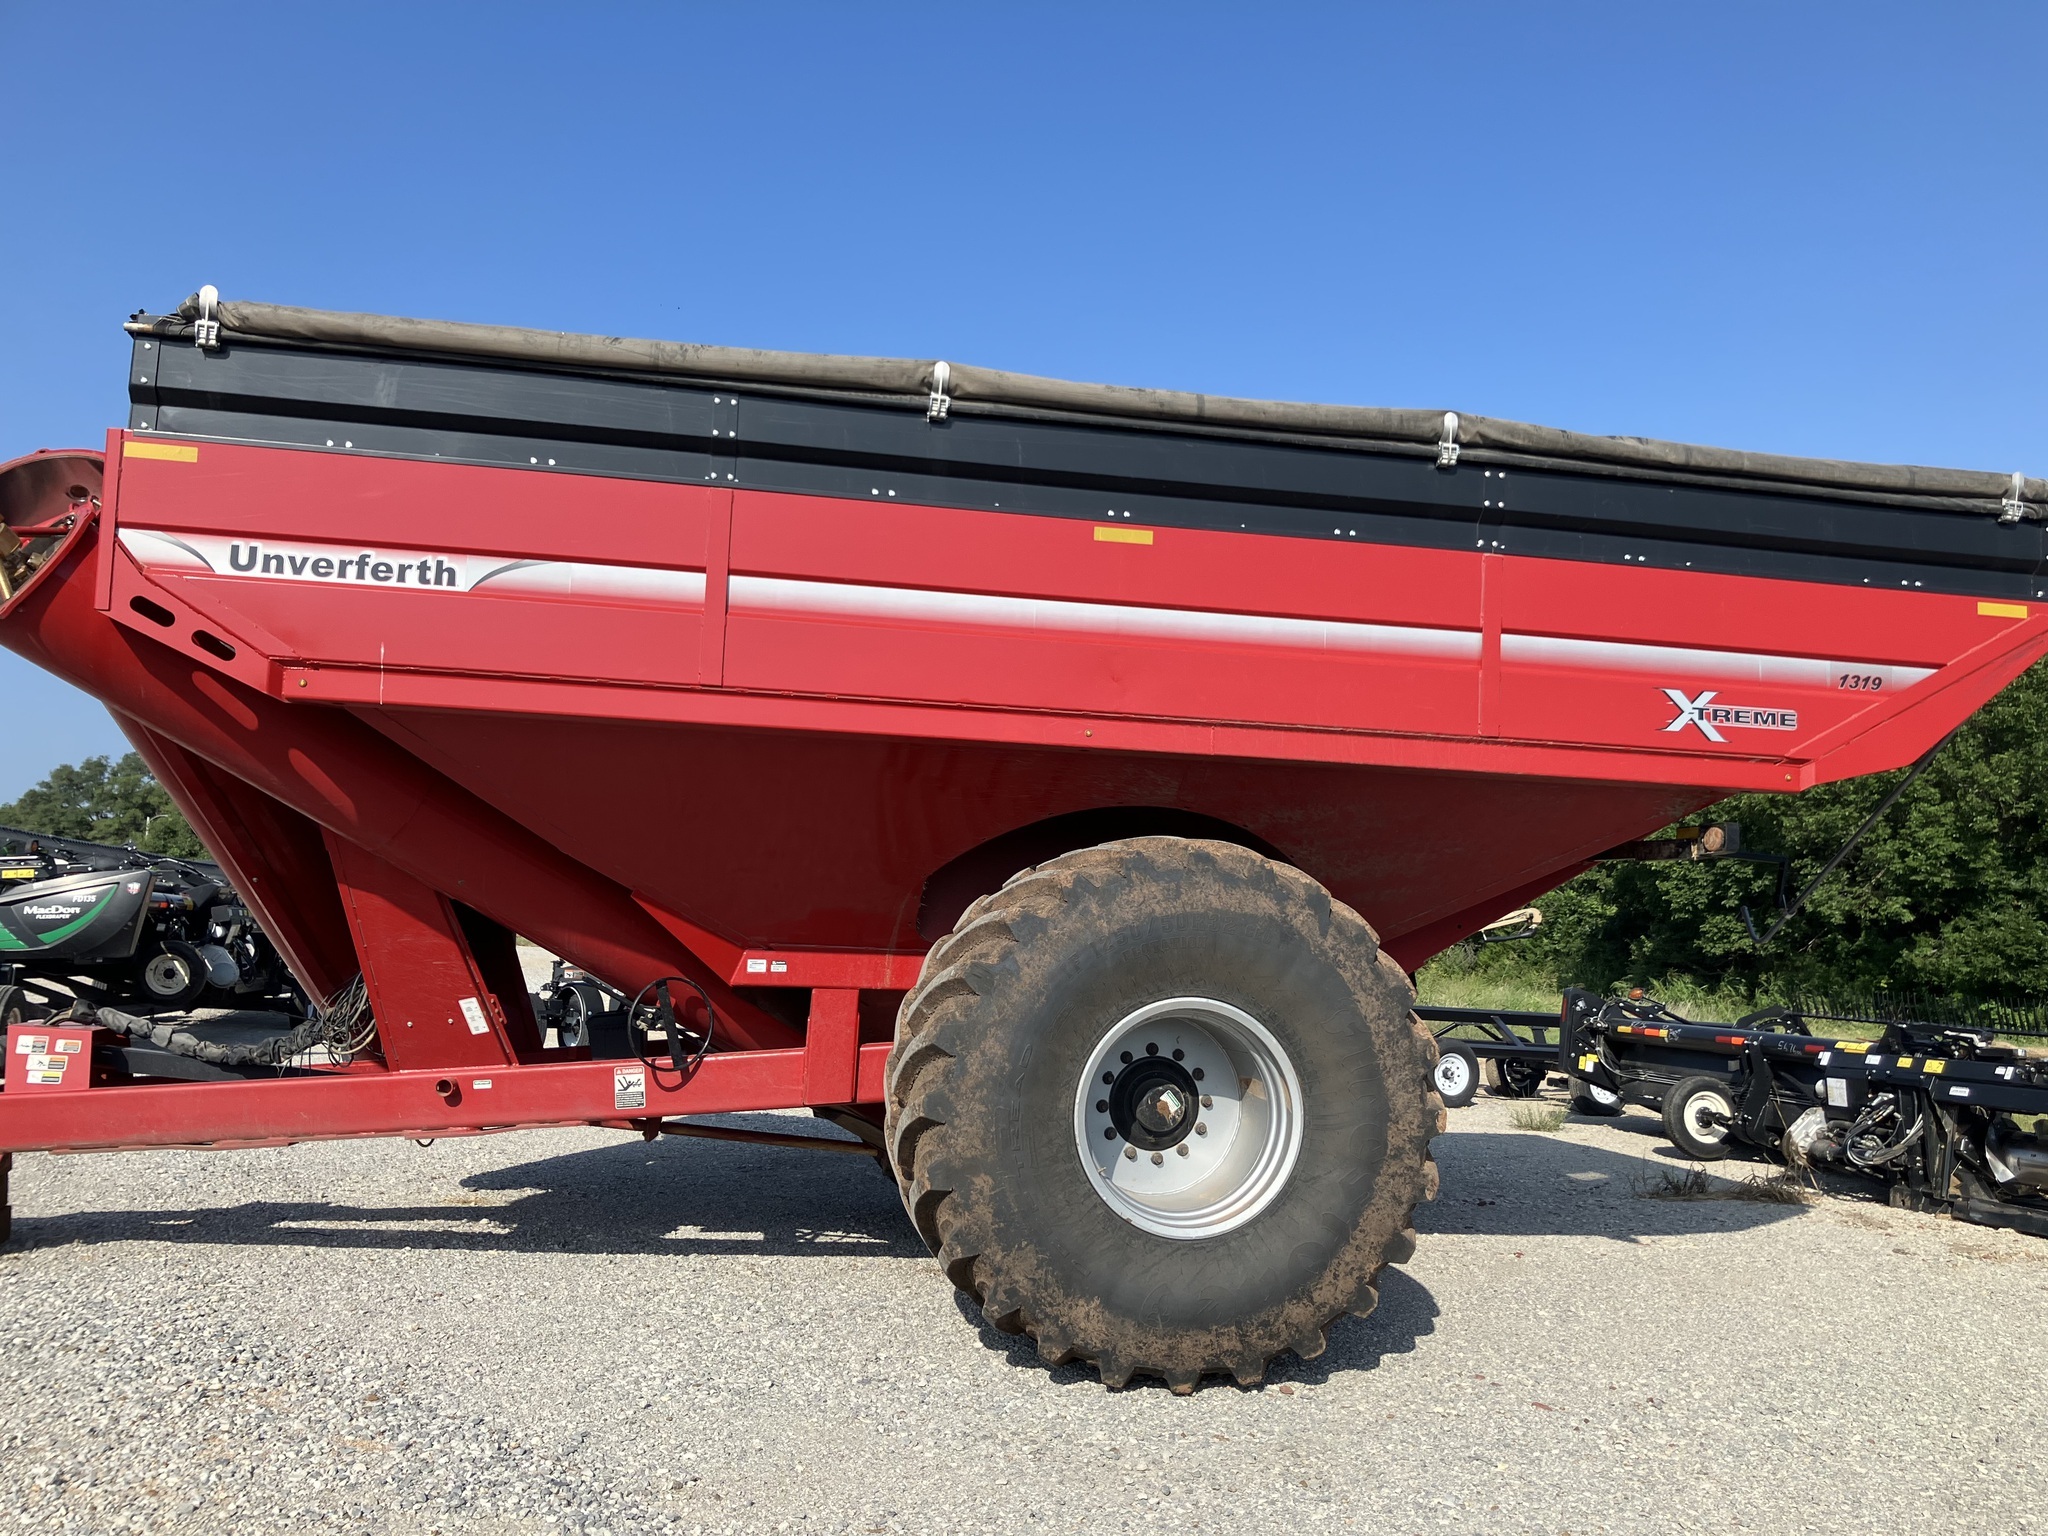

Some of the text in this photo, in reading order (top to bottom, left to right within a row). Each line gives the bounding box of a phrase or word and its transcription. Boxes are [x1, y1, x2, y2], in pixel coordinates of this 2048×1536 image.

[229, 544, 457, 587] Unverferth
[1838, 673, 1883, 692] 1319
[72, 895, 97, 903] FD135
[23, 905, 81, 914] MacDon
[1010, 1043, 1033, 1177] TREAD
